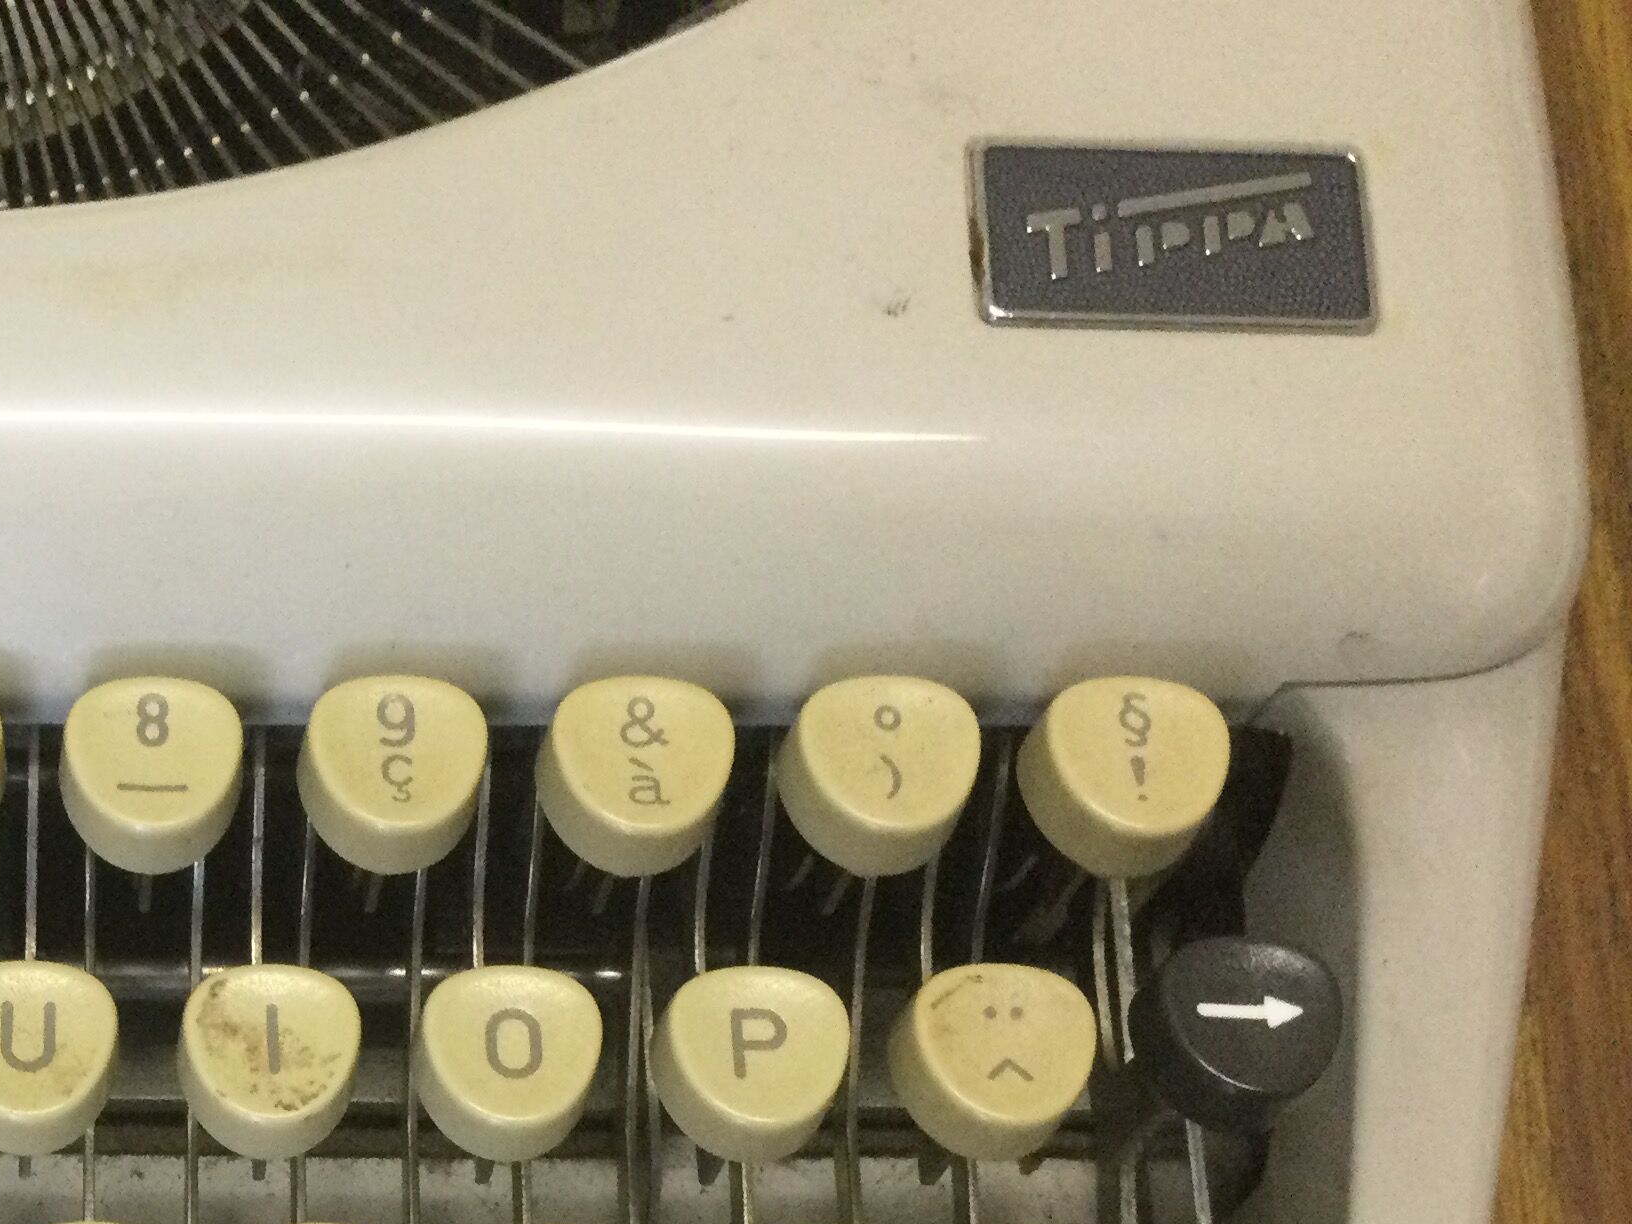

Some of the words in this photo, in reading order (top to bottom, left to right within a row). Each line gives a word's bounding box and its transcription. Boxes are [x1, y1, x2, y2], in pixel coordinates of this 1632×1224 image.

[136, 694, 169, 747] 8
[377, 695, 415, 747] 9
[620, 697, 669, 748] &
[629, 757, 670, 805] à
[880, 755, 902, 799] )
[1130, 756, 1147, 802] !
[0, 1000, 57, 1073] U
[266, 1004, 283, 1074] I
[485, 1009, 543, 1079] O
[730, 1008, 787, 1079] P
